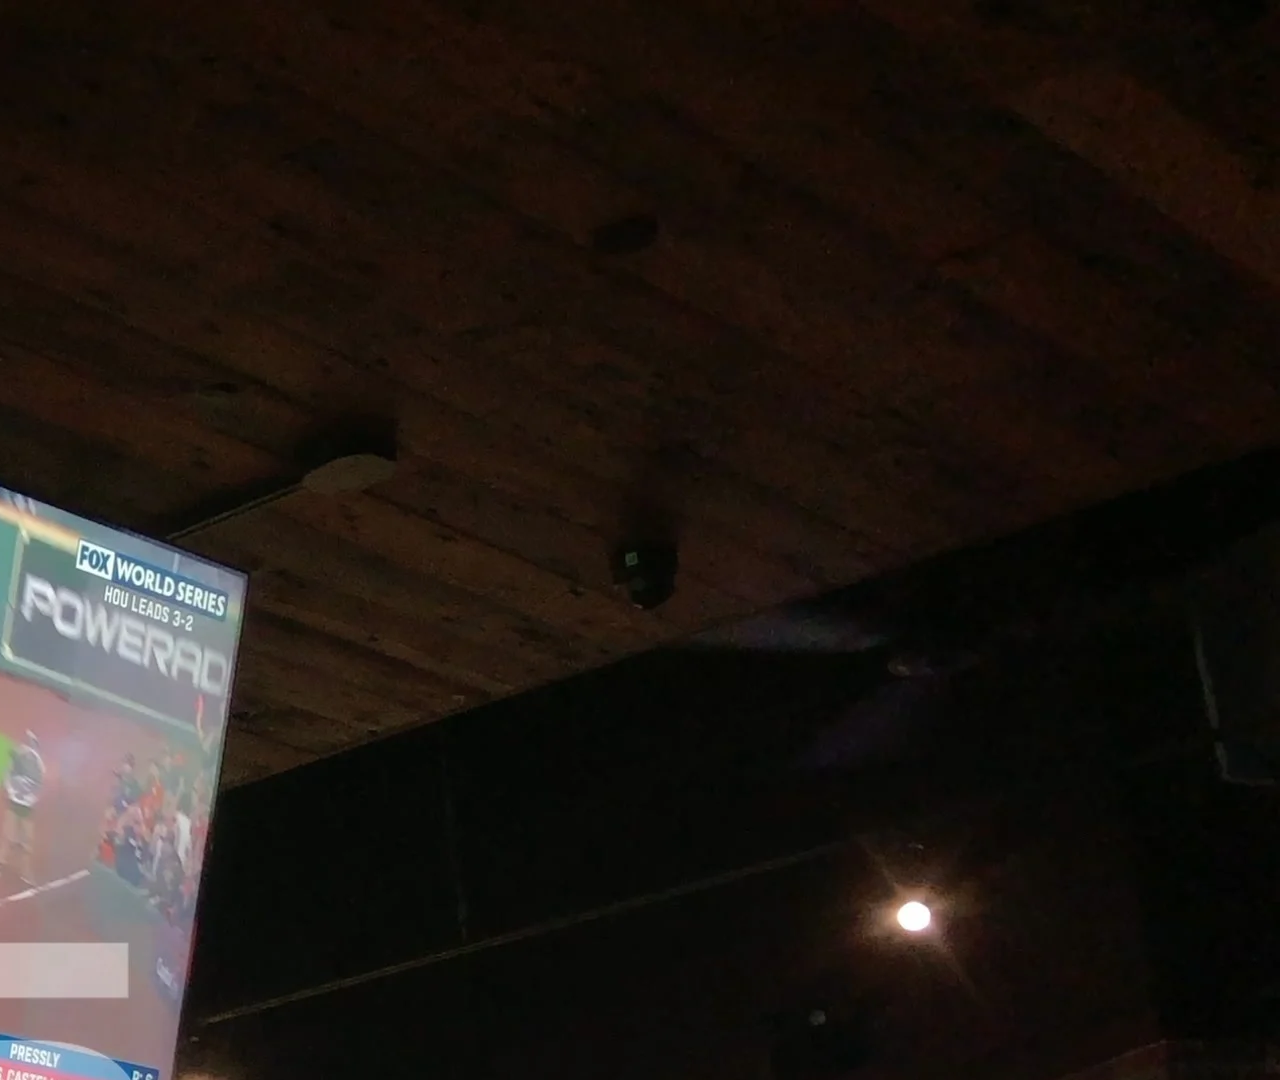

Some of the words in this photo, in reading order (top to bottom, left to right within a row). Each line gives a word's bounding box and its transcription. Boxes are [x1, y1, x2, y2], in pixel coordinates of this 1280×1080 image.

[78, 542, 114, 578] FOX
[115, 557, 175, 597] WORLD
[175, 583, 226, 617] SERIES
[104, 585, 129, 607] HOU
[131, 594, 168, 624] LEADS
[172, 611, 193, 631] 3-2
[10, 1043, 61, 1069] PRESSLY
